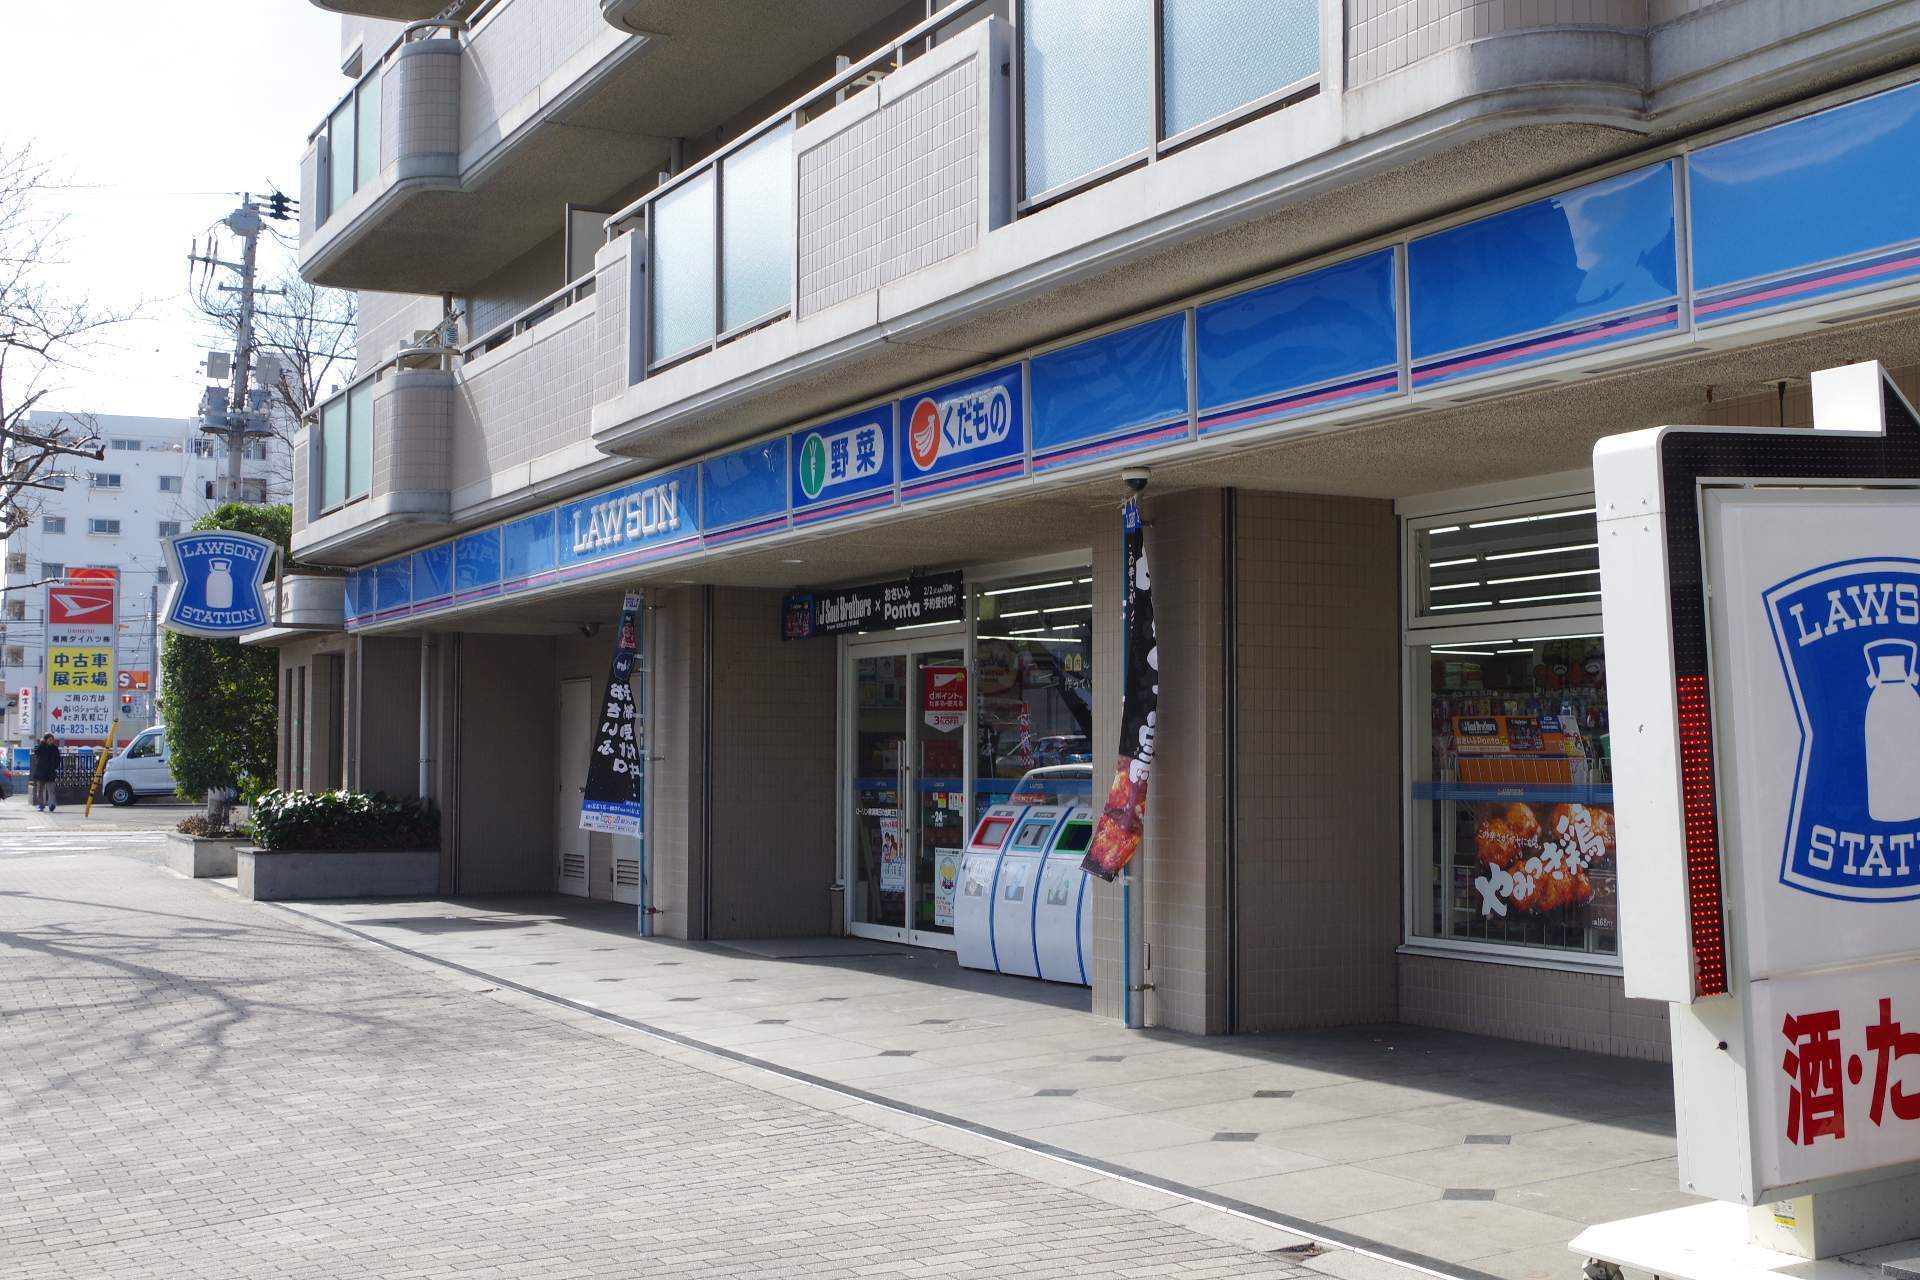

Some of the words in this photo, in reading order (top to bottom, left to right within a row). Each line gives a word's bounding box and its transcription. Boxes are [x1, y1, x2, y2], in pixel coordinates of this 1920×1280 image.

[942, 394, 1006, 448] くだもの
[831, 429, 875, 478] 野菜
[573, 480, 680, 553] LAWSON
[183, 542, 259, 561] LAWSON
[885, 586, 910, 602] おさいふ
[181, 605, 256, 624] STATION
[826, 597, 839, 623] Soul
[840, 593, 872, 621] Brothers
[885, 600, 920, 620] Ponta
[1789, 583, 1920, 647] LAWS
[54, 653, 108, 668] 中古車
[53, 671, 108, 687] 展示場
[64, 694, 105, 702] ご用の方は
[50, 724, 109, 734] 046-823-1534
[934, 810, 943, 823] 24
[1807, 824, 1920, 877] STAT
